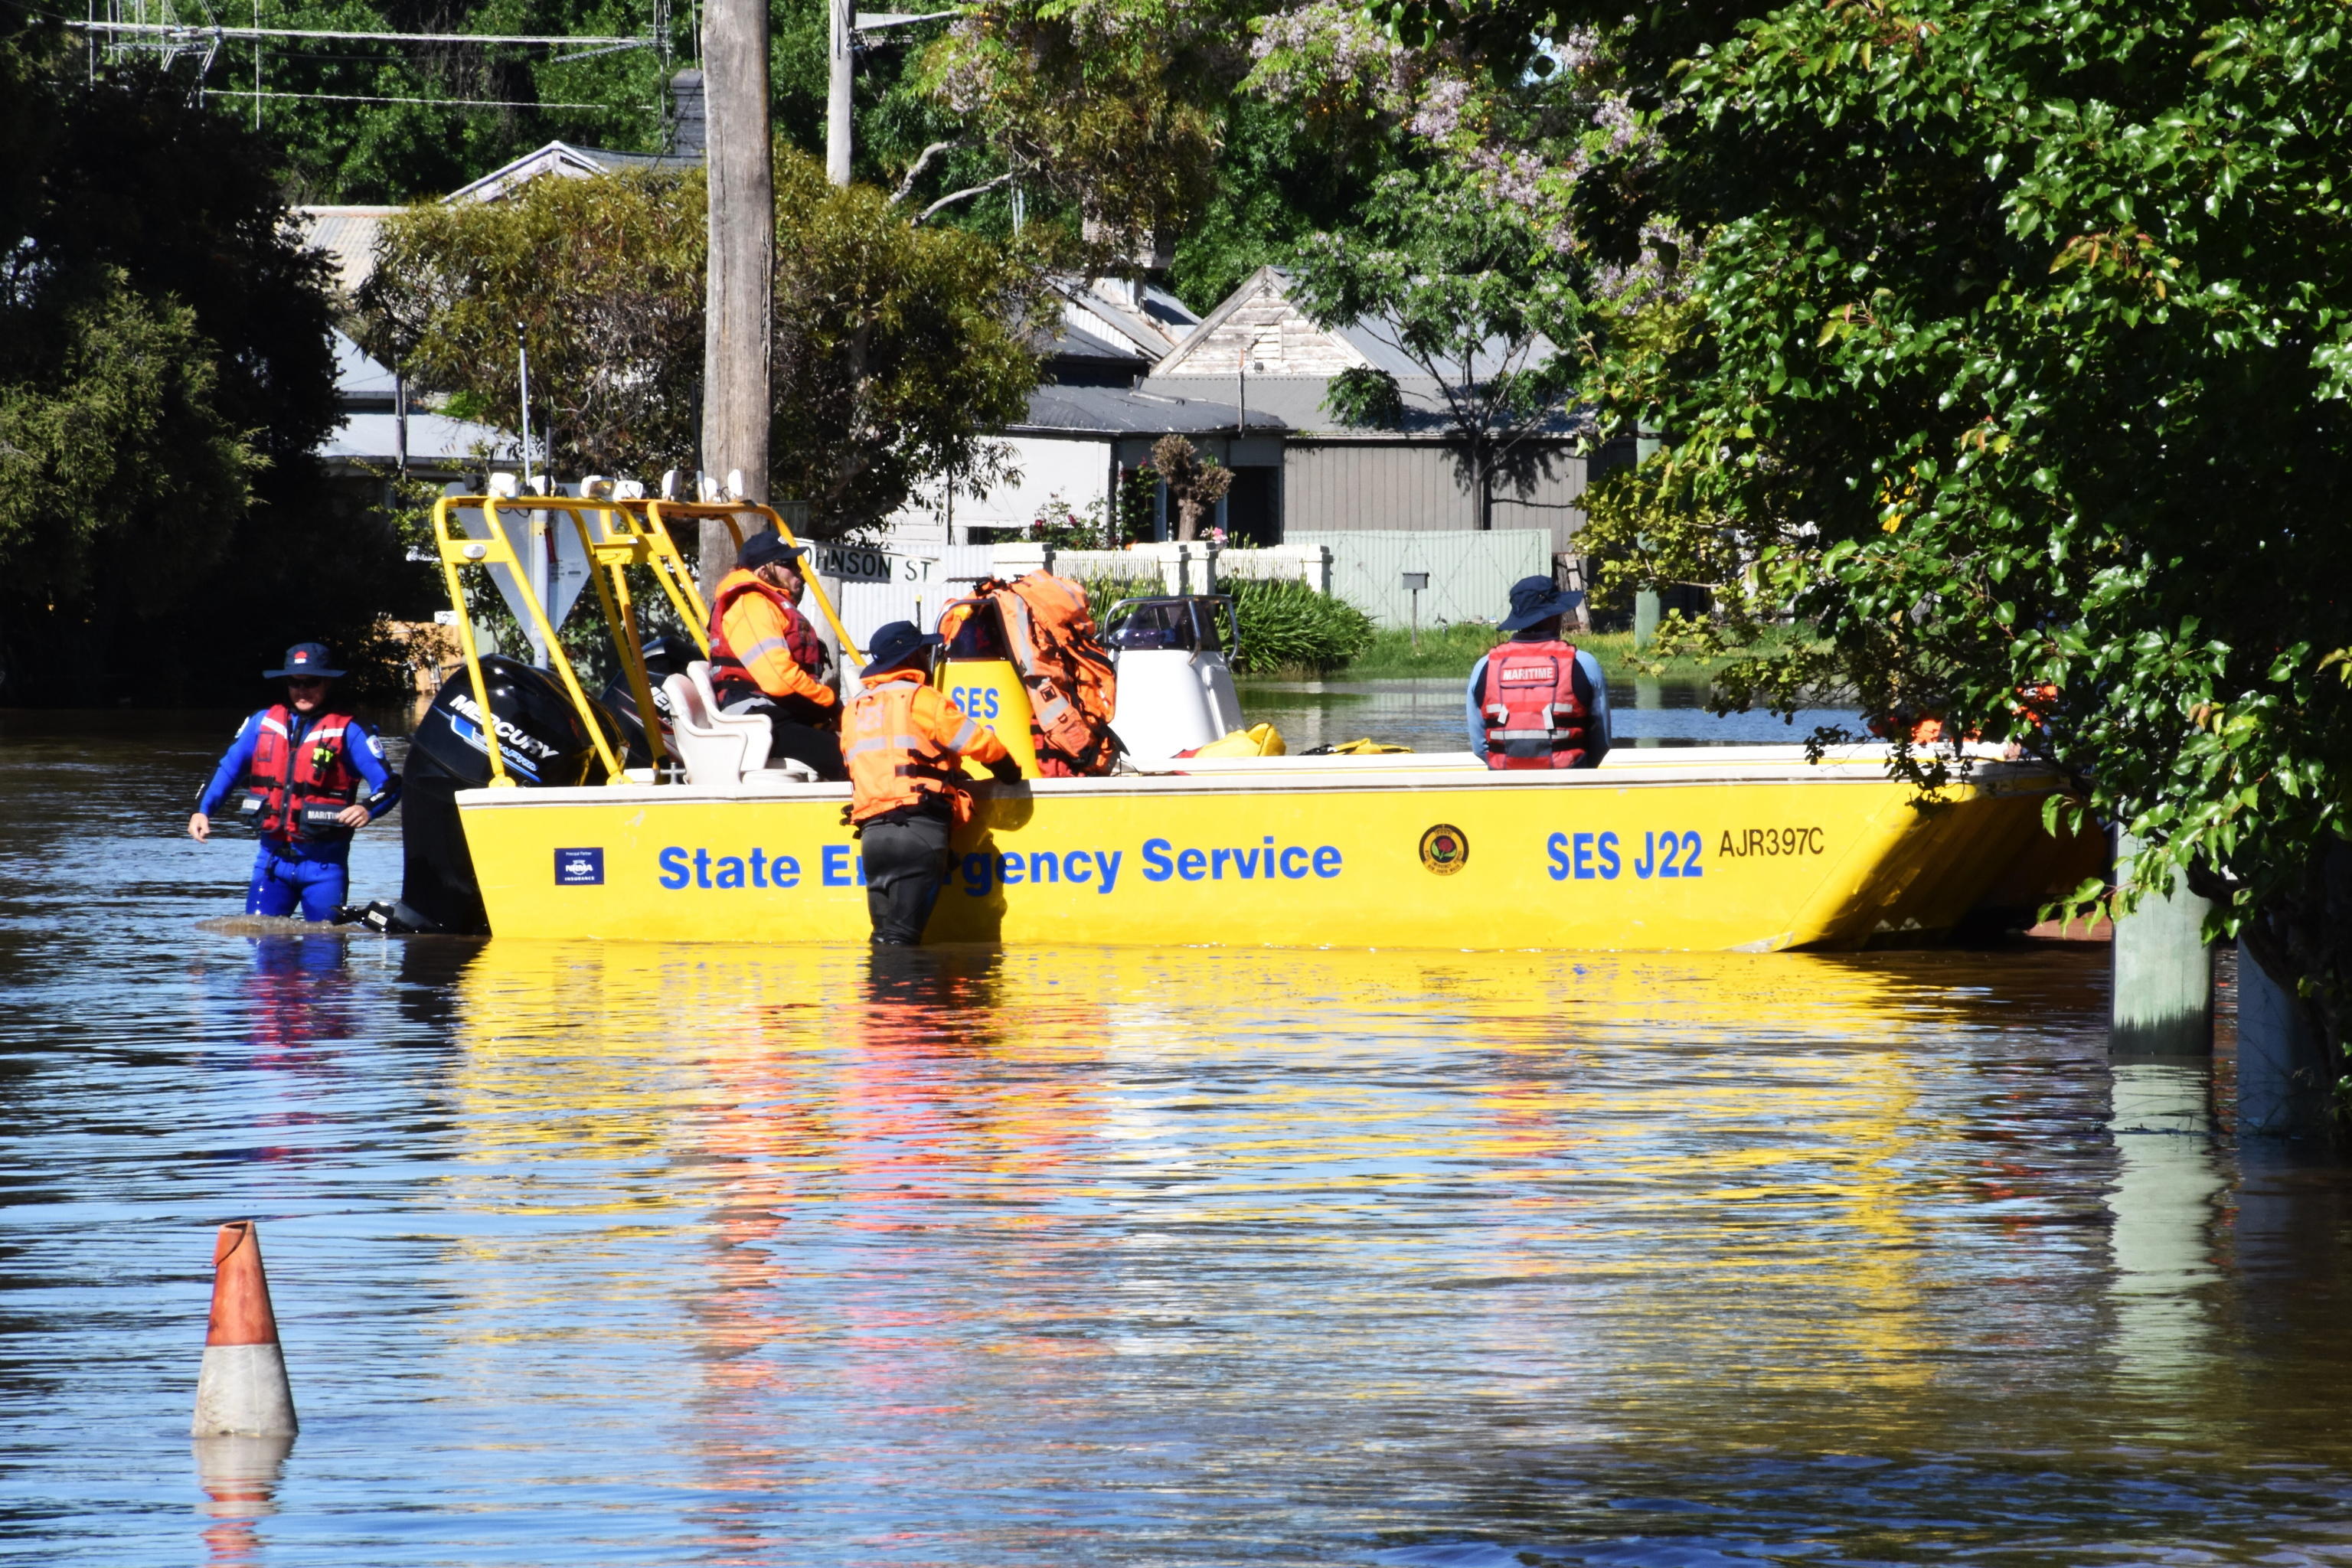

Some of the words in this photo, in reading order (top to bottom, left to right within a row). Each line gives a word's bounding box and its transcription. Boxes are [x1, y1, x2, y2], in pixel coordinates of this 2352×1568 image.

[904, 560, 932, 582] ST
[1502, 667, 1553, 681] MARITIME
[952, 686, 998, 719] SES
[308, 811, 340, 820] MARITI
[1547, 831, 1620, 880] SES
[1635, 831, 1703, 879] J22
[1719, 827, 1824, 857] AJR397C
[658, 846, 801, 890] State
[822, 844, 1122, 896] Egency
[1142, 835, 1343, 882] Service
